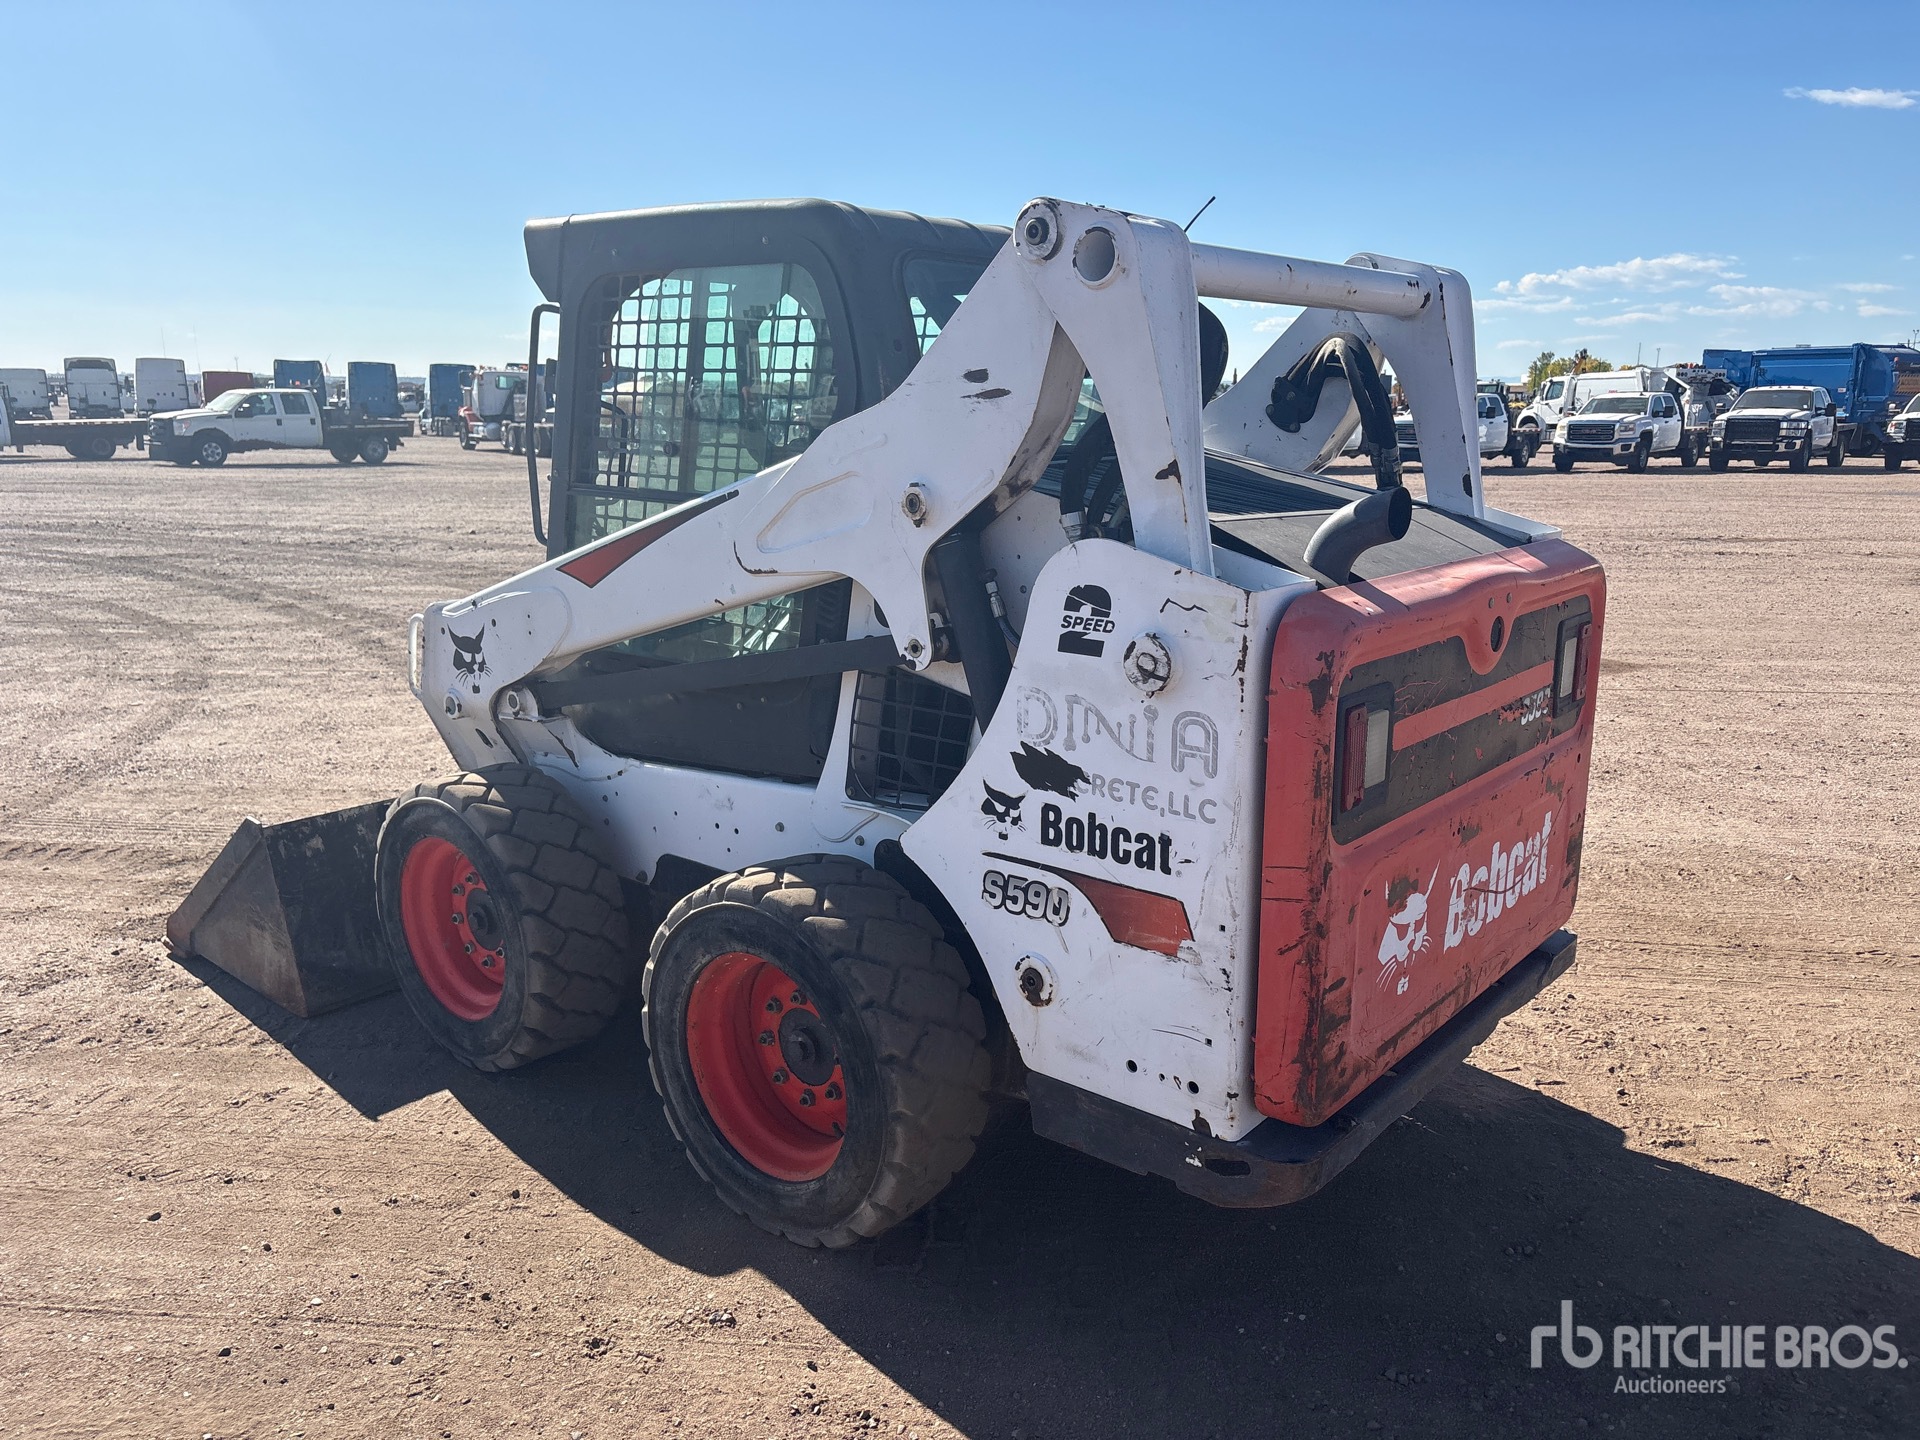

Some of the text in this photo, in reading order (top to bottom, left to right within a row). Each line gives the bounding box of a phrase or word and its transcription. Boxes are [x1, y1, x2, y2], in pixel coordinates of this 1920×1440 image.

[1060, 614, 1116, 634] SPEED
[1040, 802, 1173, 876] Bobcat
[981, 869, 1072, 927] S590
[1443, 811, 1552, 954] Bobcat
